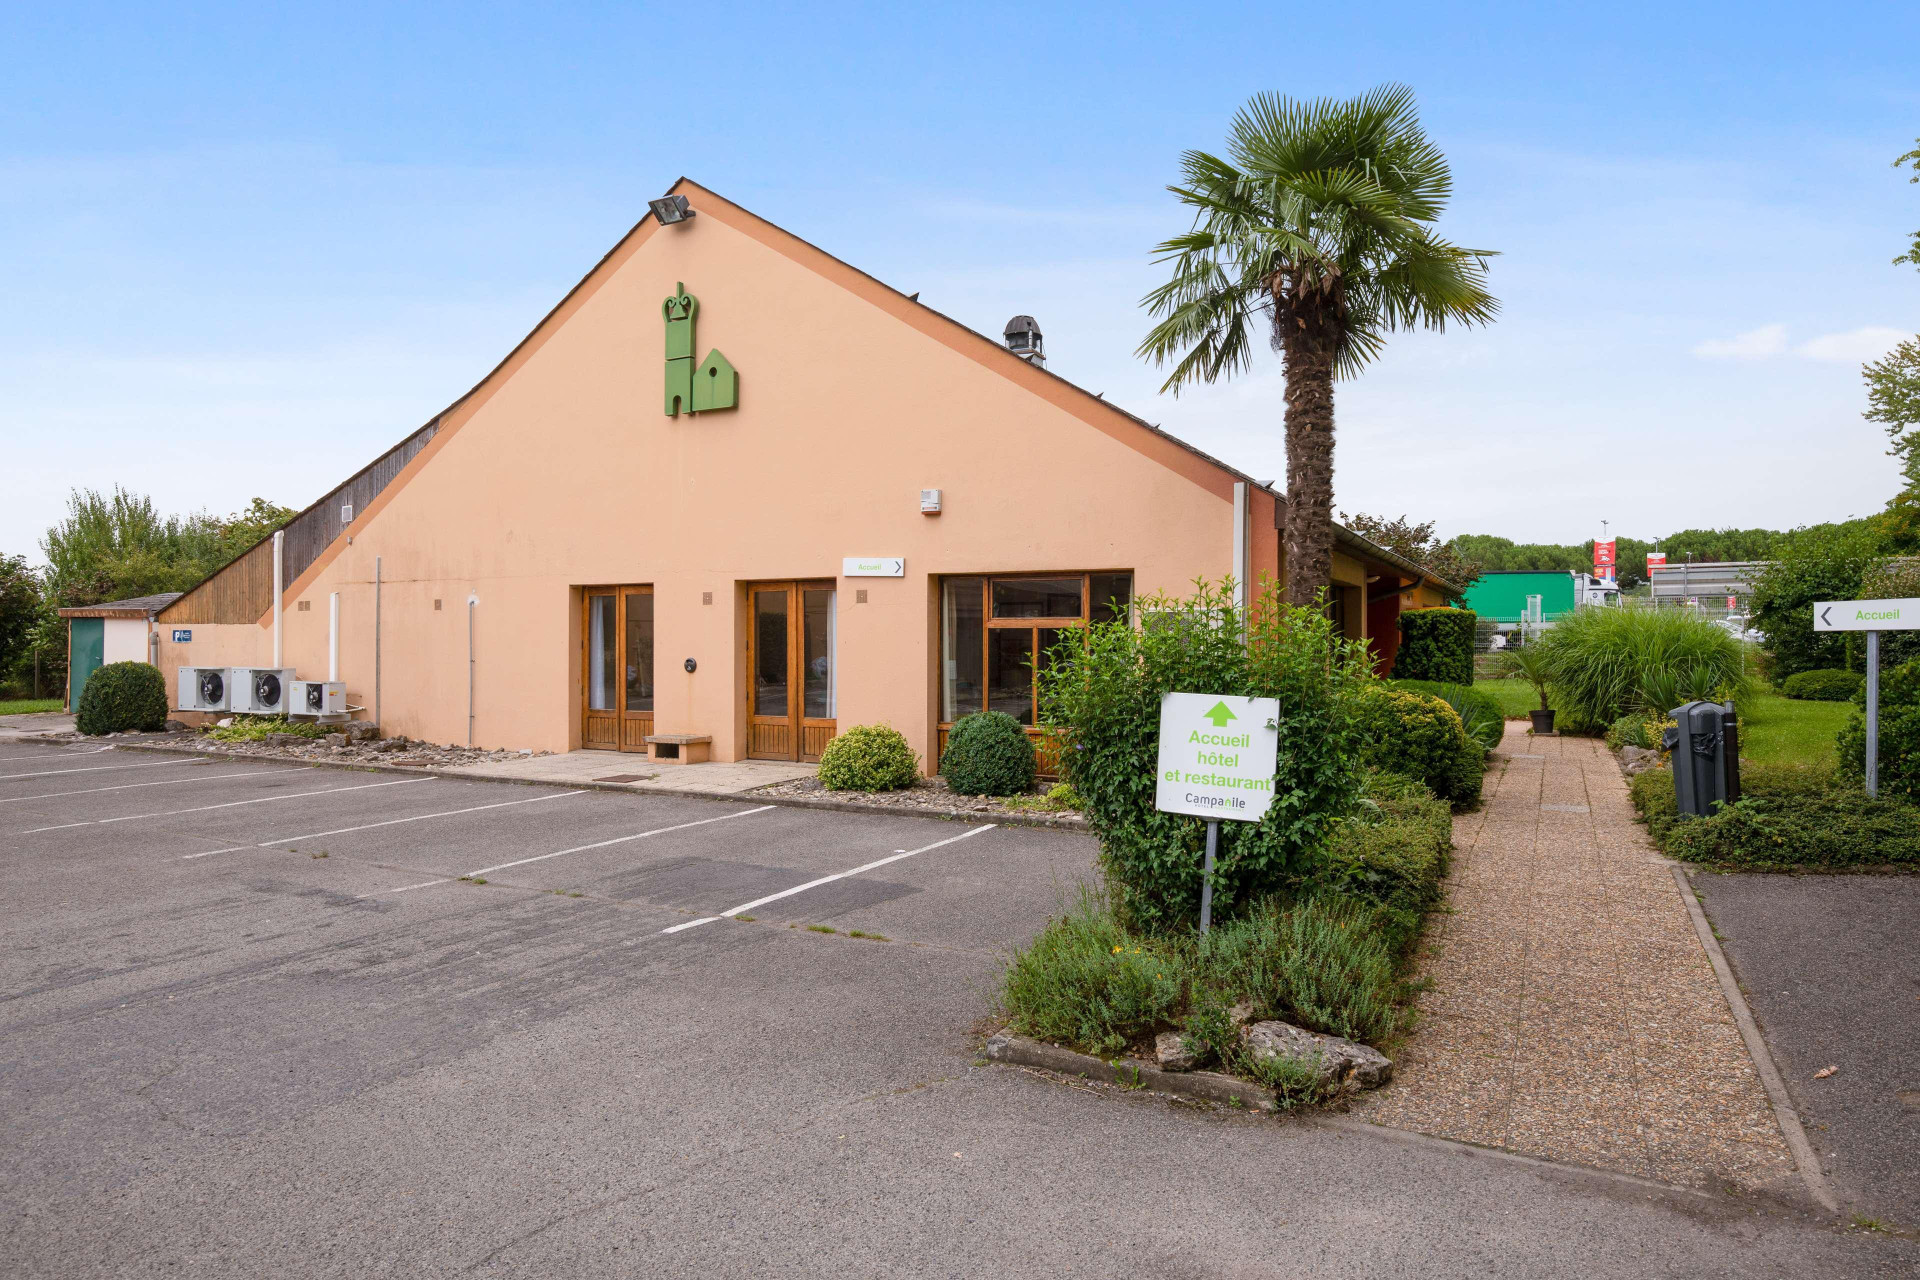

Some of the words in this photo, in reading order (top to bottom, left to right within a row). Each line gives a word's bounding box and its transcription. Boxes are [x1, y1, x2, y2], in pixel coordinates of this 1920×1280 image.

[858, 563, 882, 571] Accueil
[1855, 608, 1900, 621] Accueil
[1188, 730, 1250, 748] Accueil
[1197, 750, 1239, 768] hôtel
[1164, 769, 1181, 782] et
[1184, 771, 1272, 791] restaurant
[1185, 792, 1246, 809] Campanile
